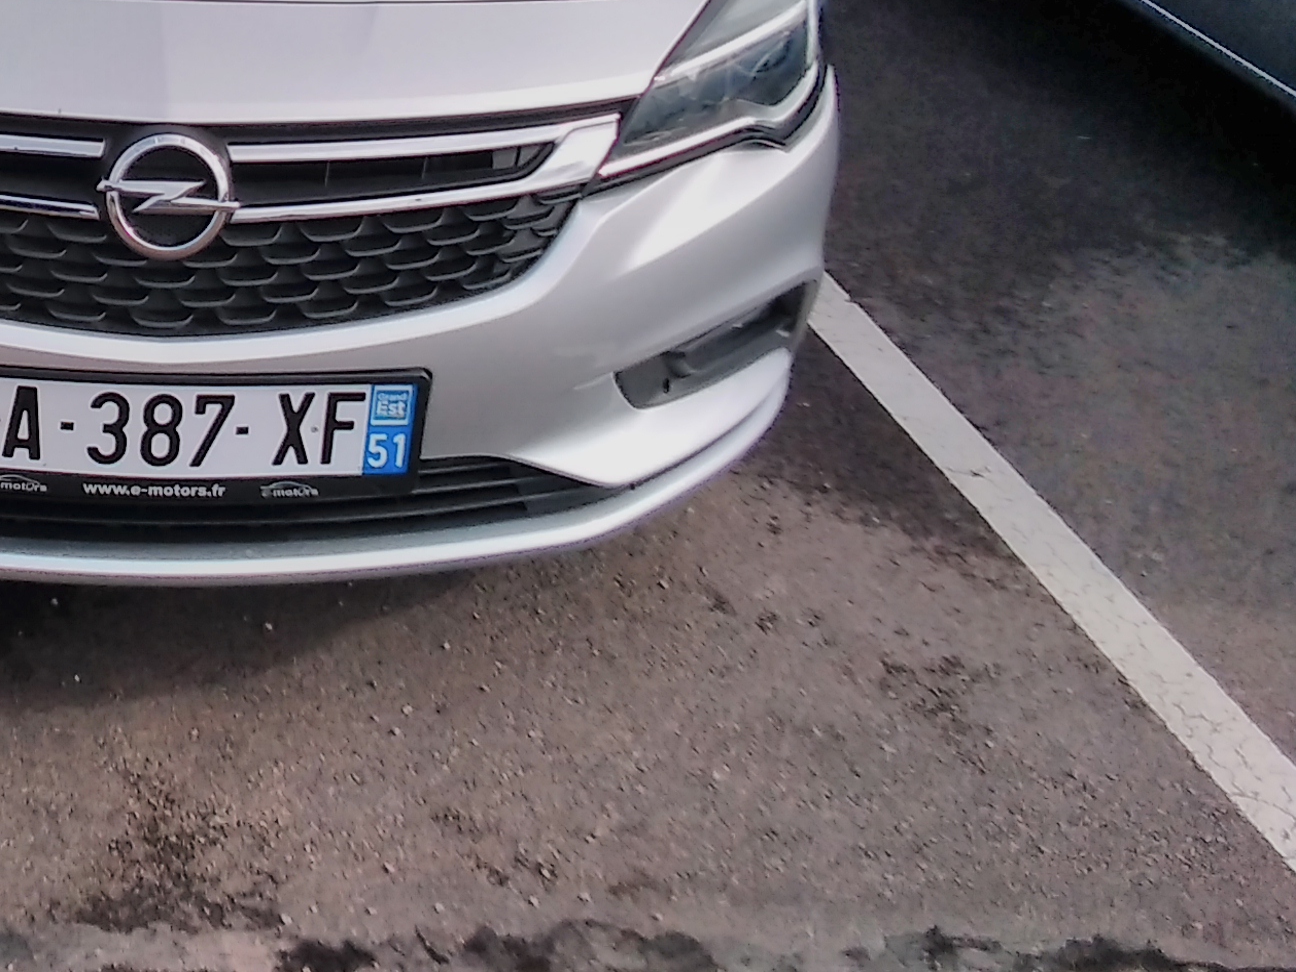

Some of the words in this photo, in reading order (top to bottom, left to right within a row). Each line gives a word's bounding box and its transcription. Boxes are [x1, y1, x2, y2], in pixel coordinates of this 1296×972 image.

[376, 400, 406, 418] Est
[366, 432, 407, 468] 51
[82, 482, 226, 498] www.e-motors.fr
